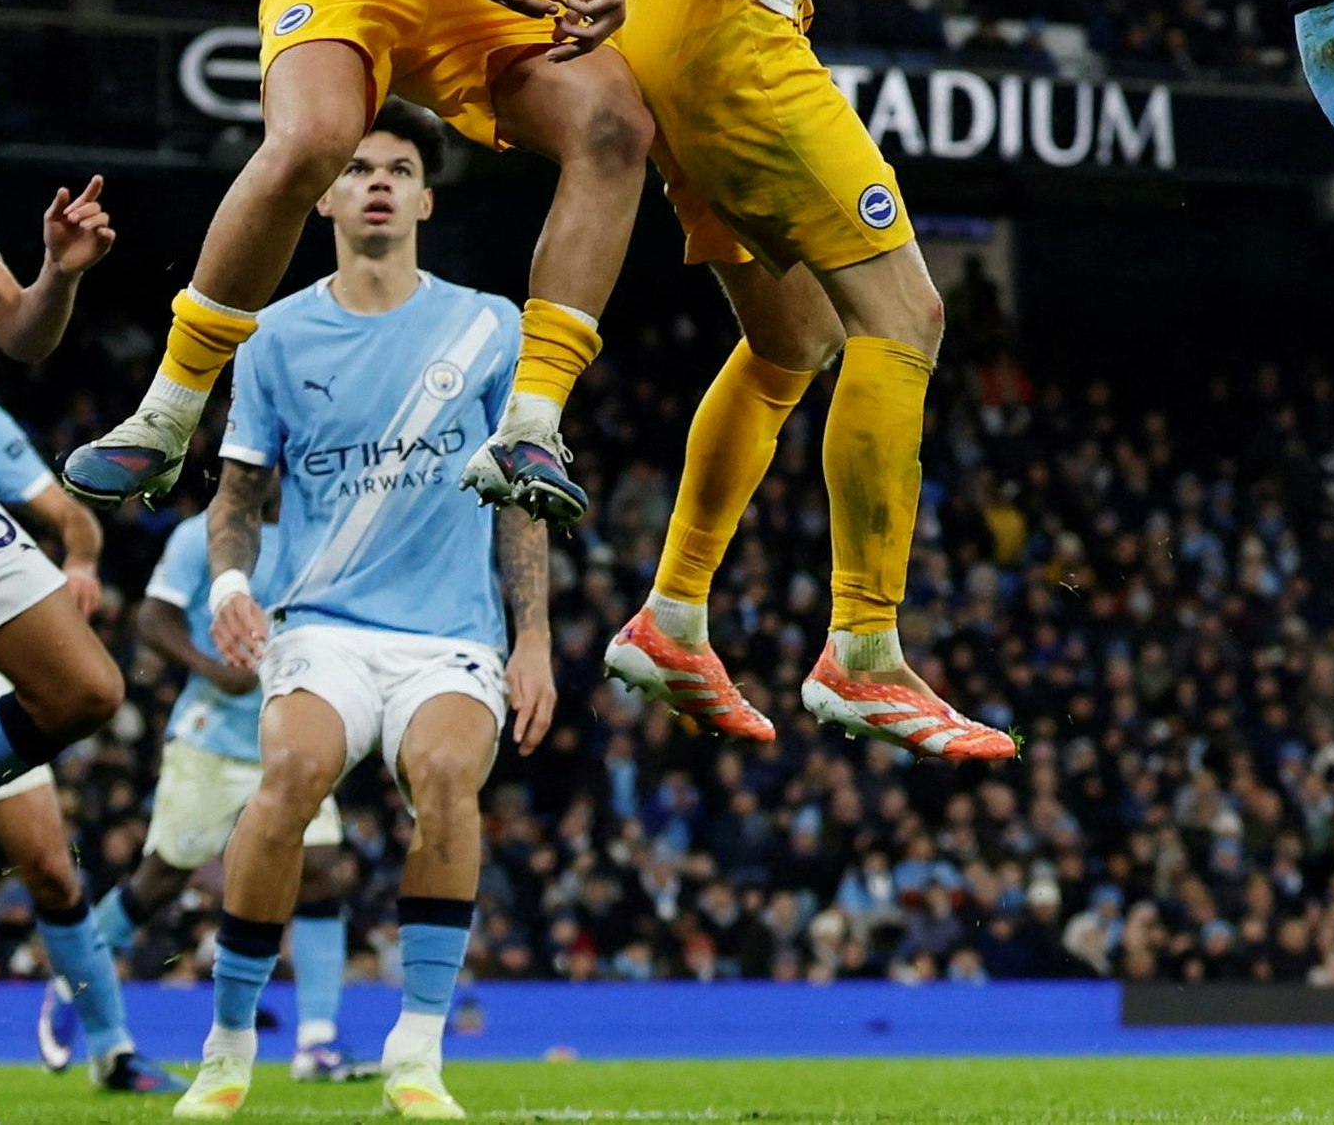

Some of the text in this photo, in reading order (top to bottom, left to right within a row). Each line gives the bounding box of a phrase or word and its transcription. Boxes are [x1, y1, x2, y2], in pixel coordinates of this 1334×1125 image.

[830, 64, 1177, 170] TADIUM
[304, 428, 466, 476] ETIHAD
[339, 466, 444, 497] AIRWAYS
